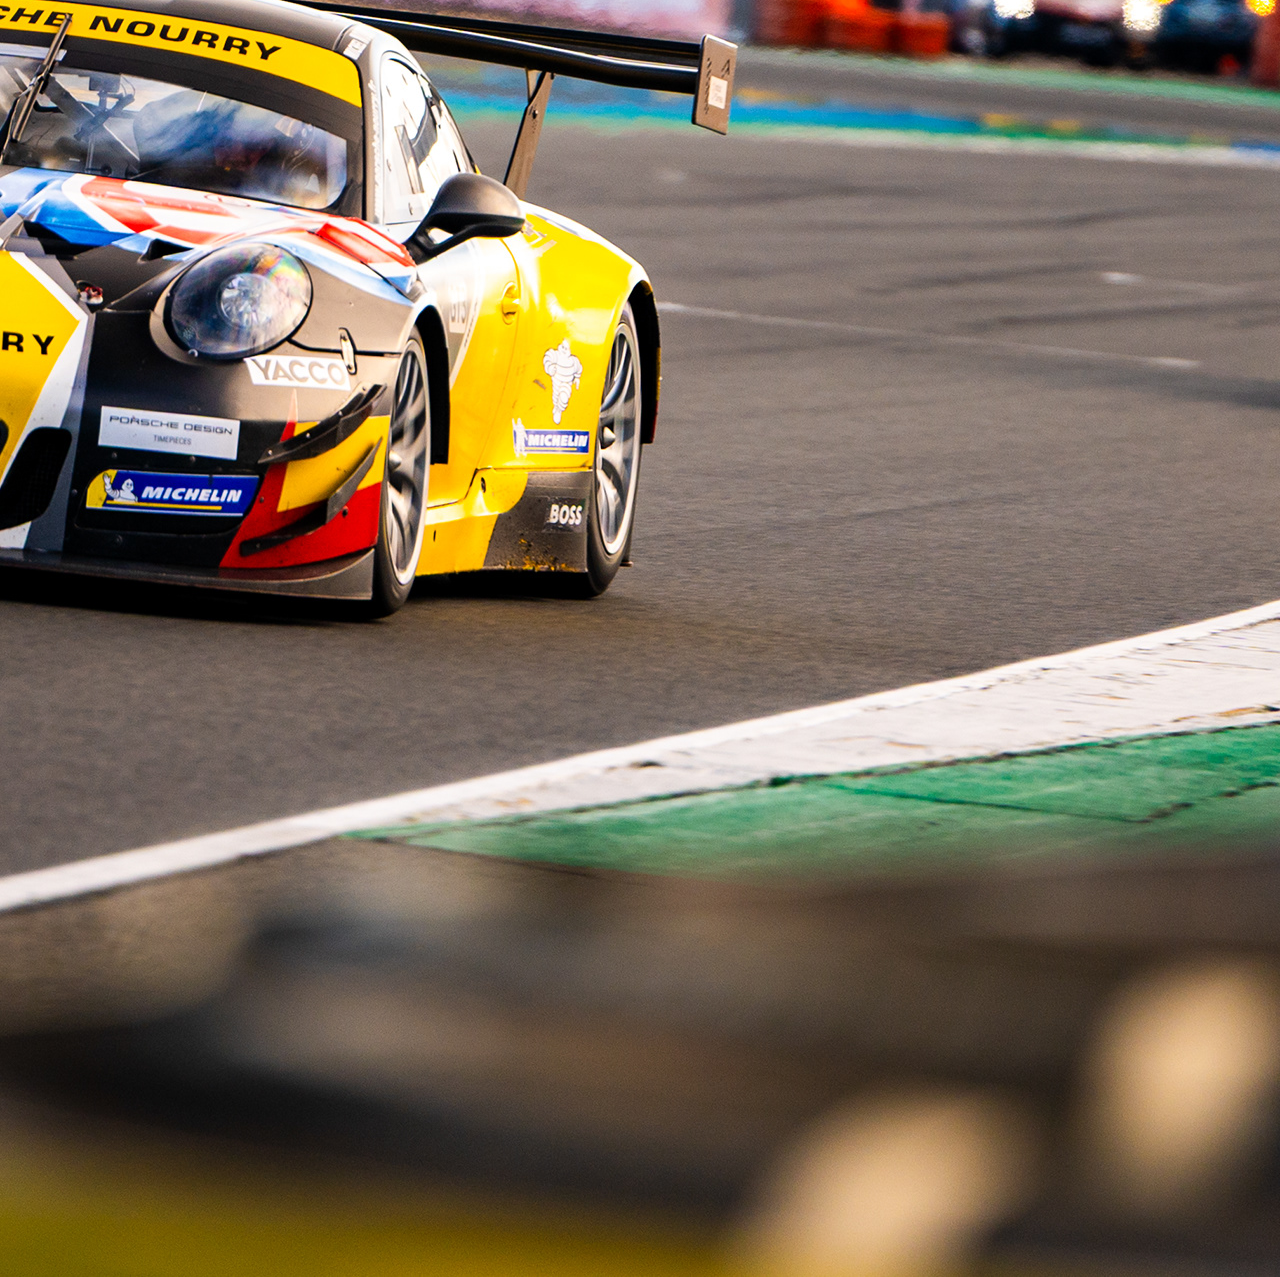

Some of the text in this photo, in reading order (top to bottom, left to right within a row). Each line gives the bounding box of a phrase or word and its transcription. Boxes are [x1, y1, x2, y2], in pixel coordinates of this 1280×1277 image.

[89, 14, 283, 61] NOURRY
[252, 358, 346, 386] YACCO
[109, 415, 233, 435] PORSCHE DESIGN
[153, 435, 192, 446] TIMEPIECES
[528, 433, 588, 447] MICHELIN
[141, 486, 242, 503] MICHELIN
[549, 504, 583, 525] BOSS
